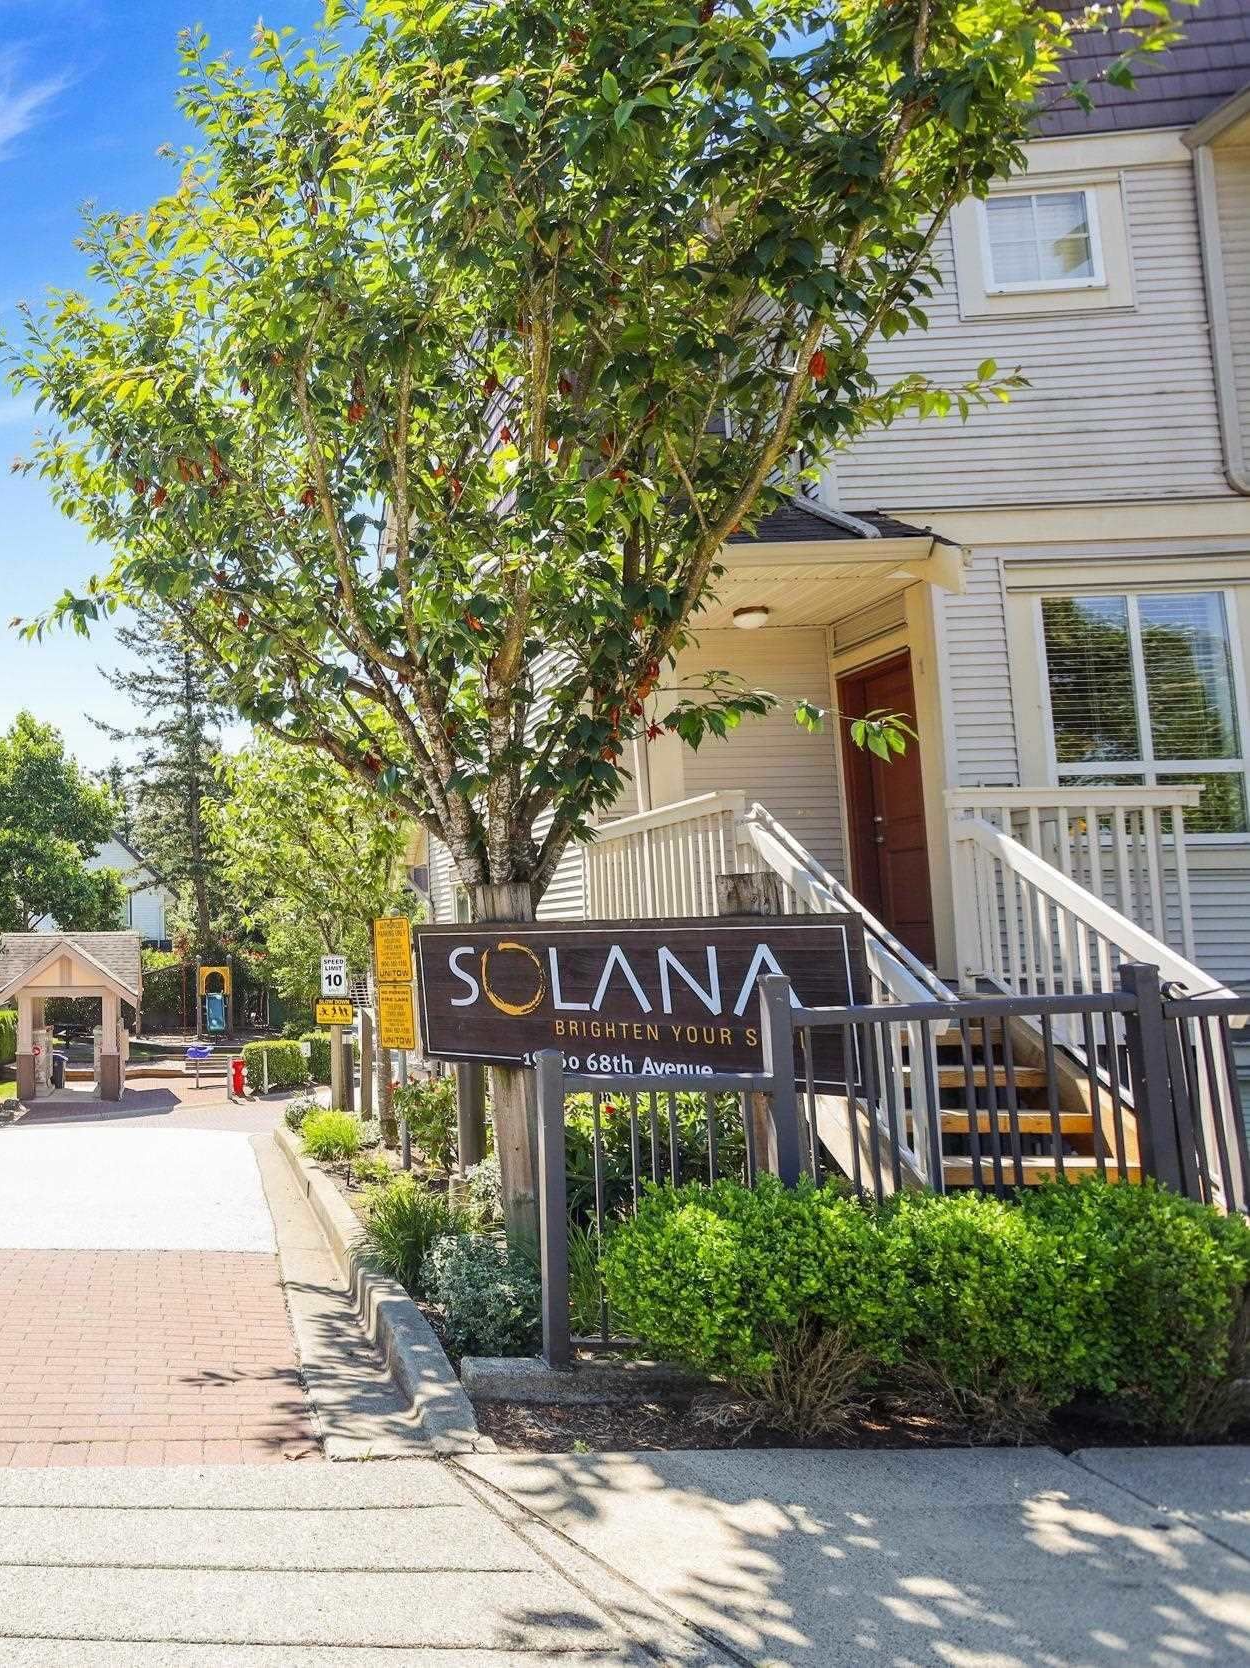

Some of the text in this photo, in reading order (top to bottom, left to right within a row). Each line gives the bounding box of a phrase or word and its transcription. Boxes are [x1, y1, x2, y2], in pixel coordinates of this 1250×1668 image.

[325, 974, 343, 987] 10
[448, 942, 803, 1017] SOLANA
[555, 1019, 659, 1041] BRIGHTEN
[671, 1025, 733, 1046] YOUR
[586, 1053, 633, 1074] 68th
[641, 1056, 714, 1075] Avenue
